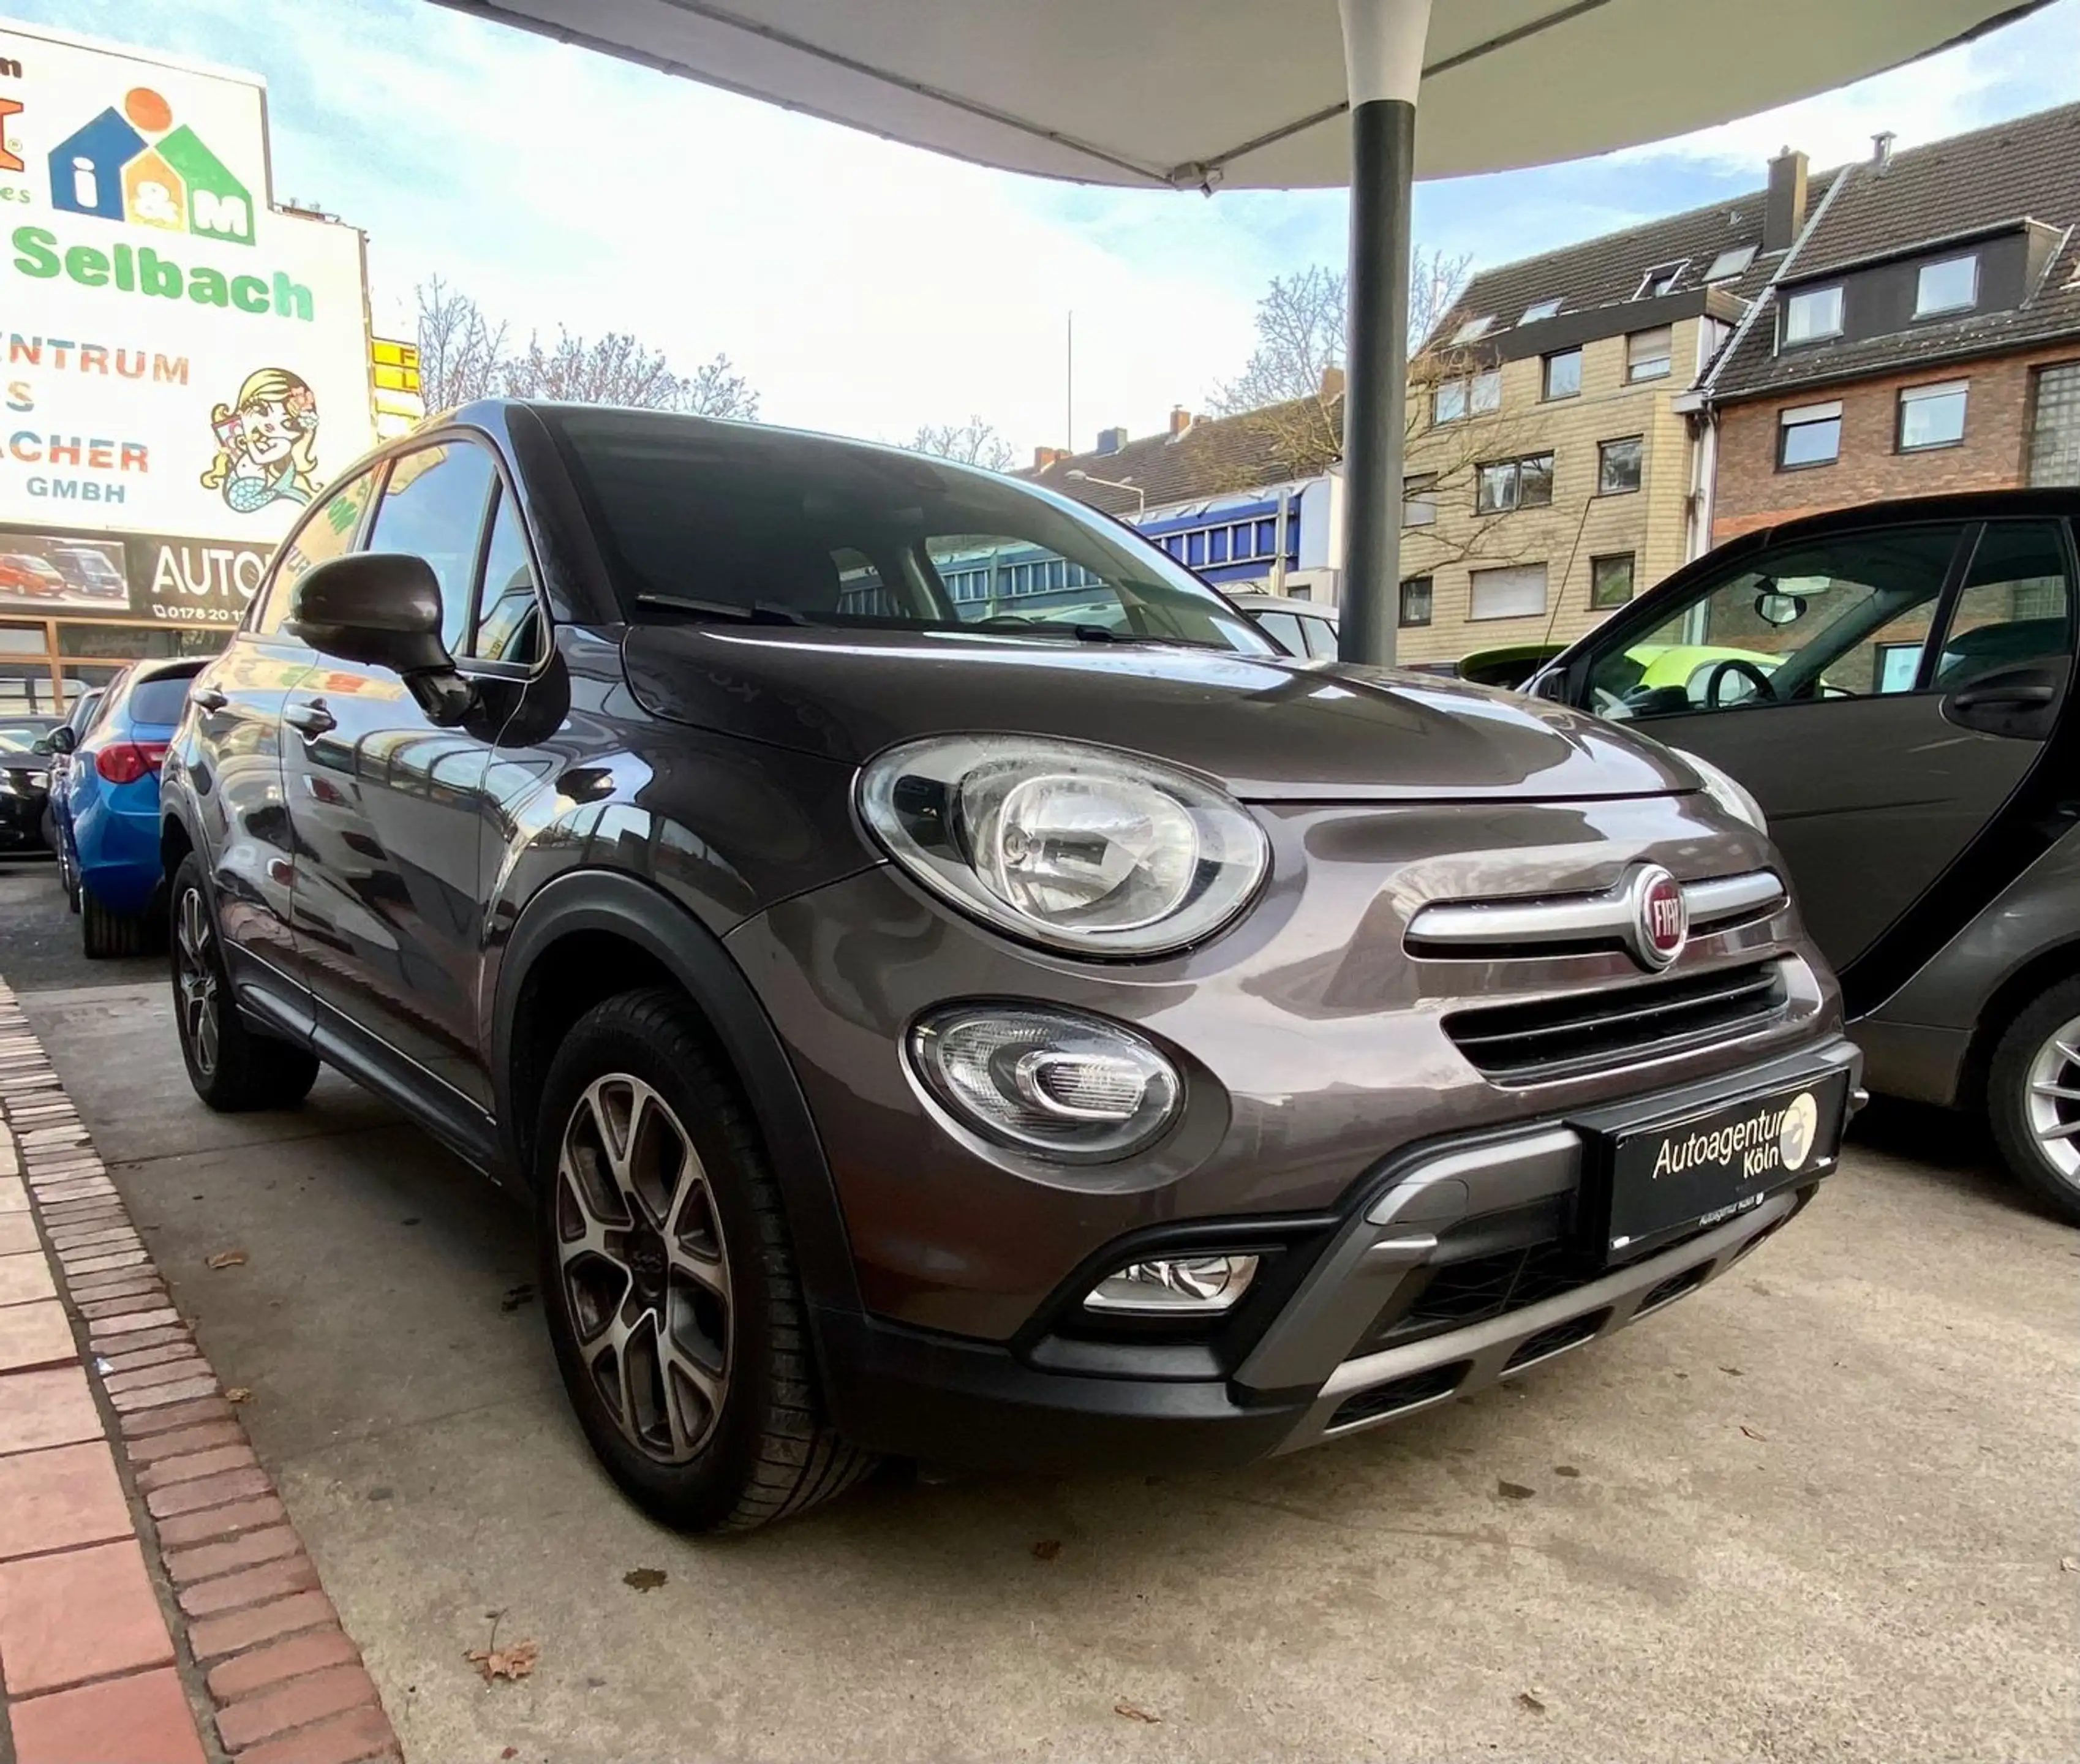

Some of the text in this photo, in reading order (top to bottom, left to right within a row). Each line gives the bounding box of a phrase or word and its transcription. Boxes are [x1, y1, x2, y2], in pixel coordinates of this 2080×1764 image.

[12, 226, 314, 322] Selbach
[0, 333, 189, 385] NTRUM
[6, 381, 34, 412] S
[0, 431, 148, 473] CHER
[26, 477, 126, 503] GMBH
[151, 545, 273, 598] AUTO
[208, 609, 228, 620] 20
[1654, 898, 1678, 938] FIAT
[1652, 1109, 1786, 1179] Autoagentur
[1743, 1142, 1779, 1179] Köln
